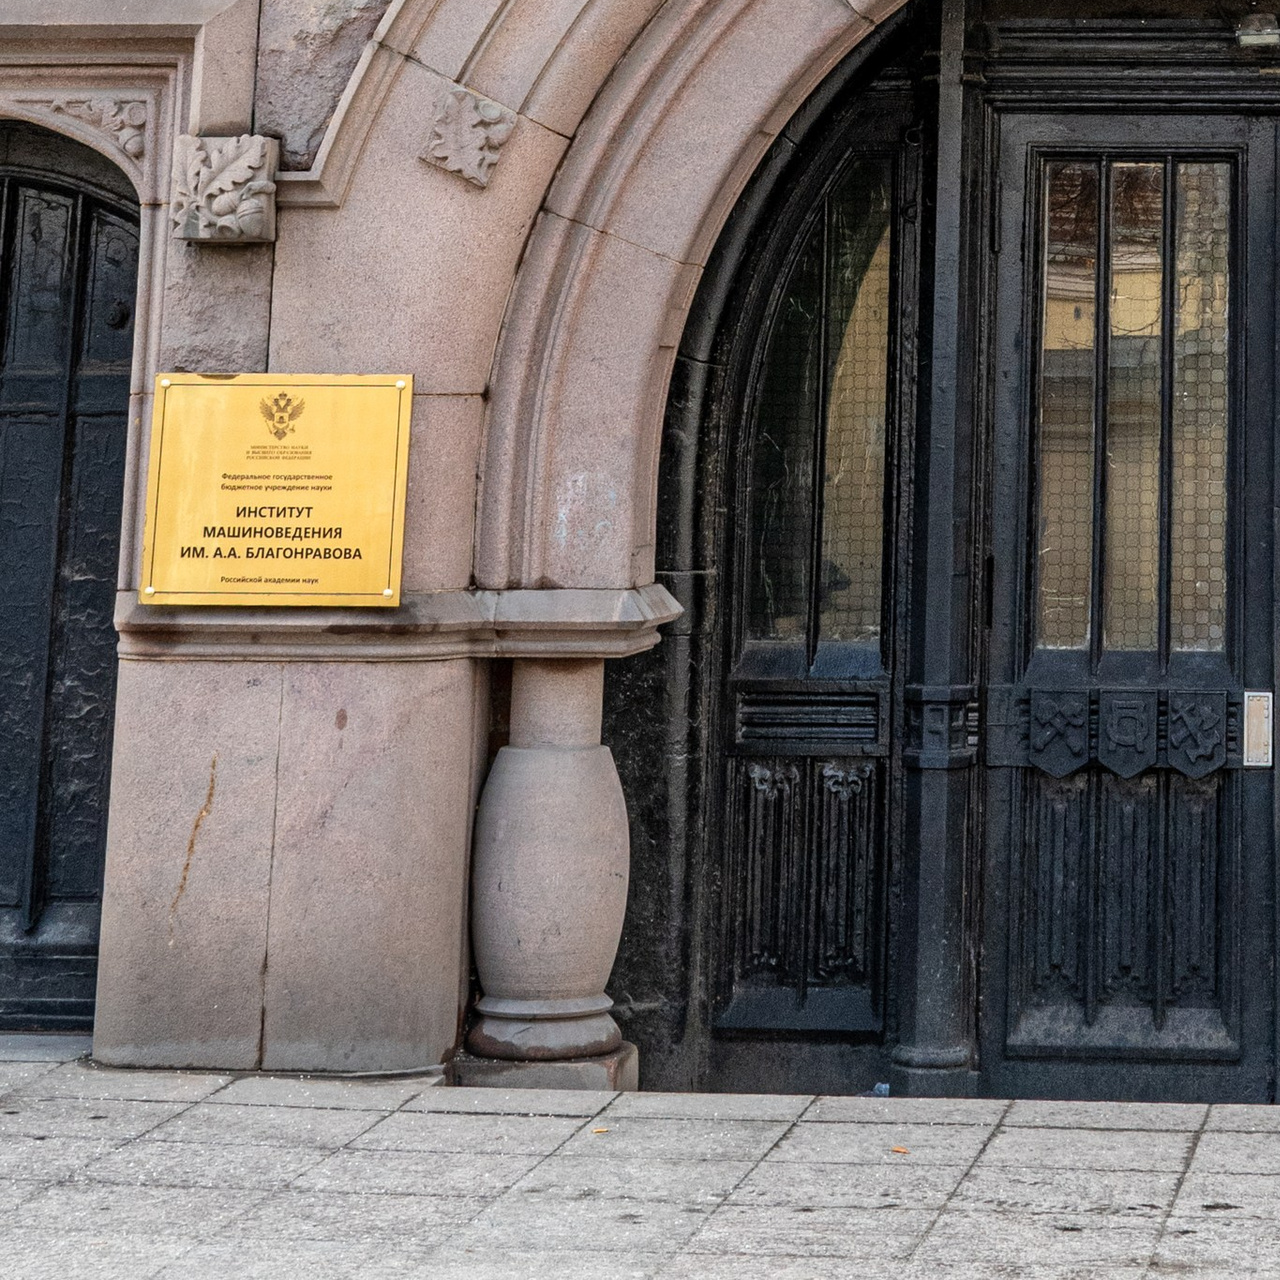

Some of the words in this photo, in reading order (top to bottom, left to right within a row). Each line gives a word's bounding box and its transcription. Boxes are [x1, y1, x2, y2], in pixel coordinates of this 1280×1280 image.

[221, 473, 271, 481] Федеральное
[272, 474, 333, 482] государственное
[221, 483, 263, 491] бюджетное
[235, 506, 313, 518] ИНСТИТУТ
[203, 526, 343, 541] МАШИНОВЕДЕНИЯ
[180, 546, 209, 559] ИМ.
[213, 547, 241, 559] А.А.
[245, 547, 363, 560] БЛАГОНРАВОВА
[220, 576, 262, 584] Российской
